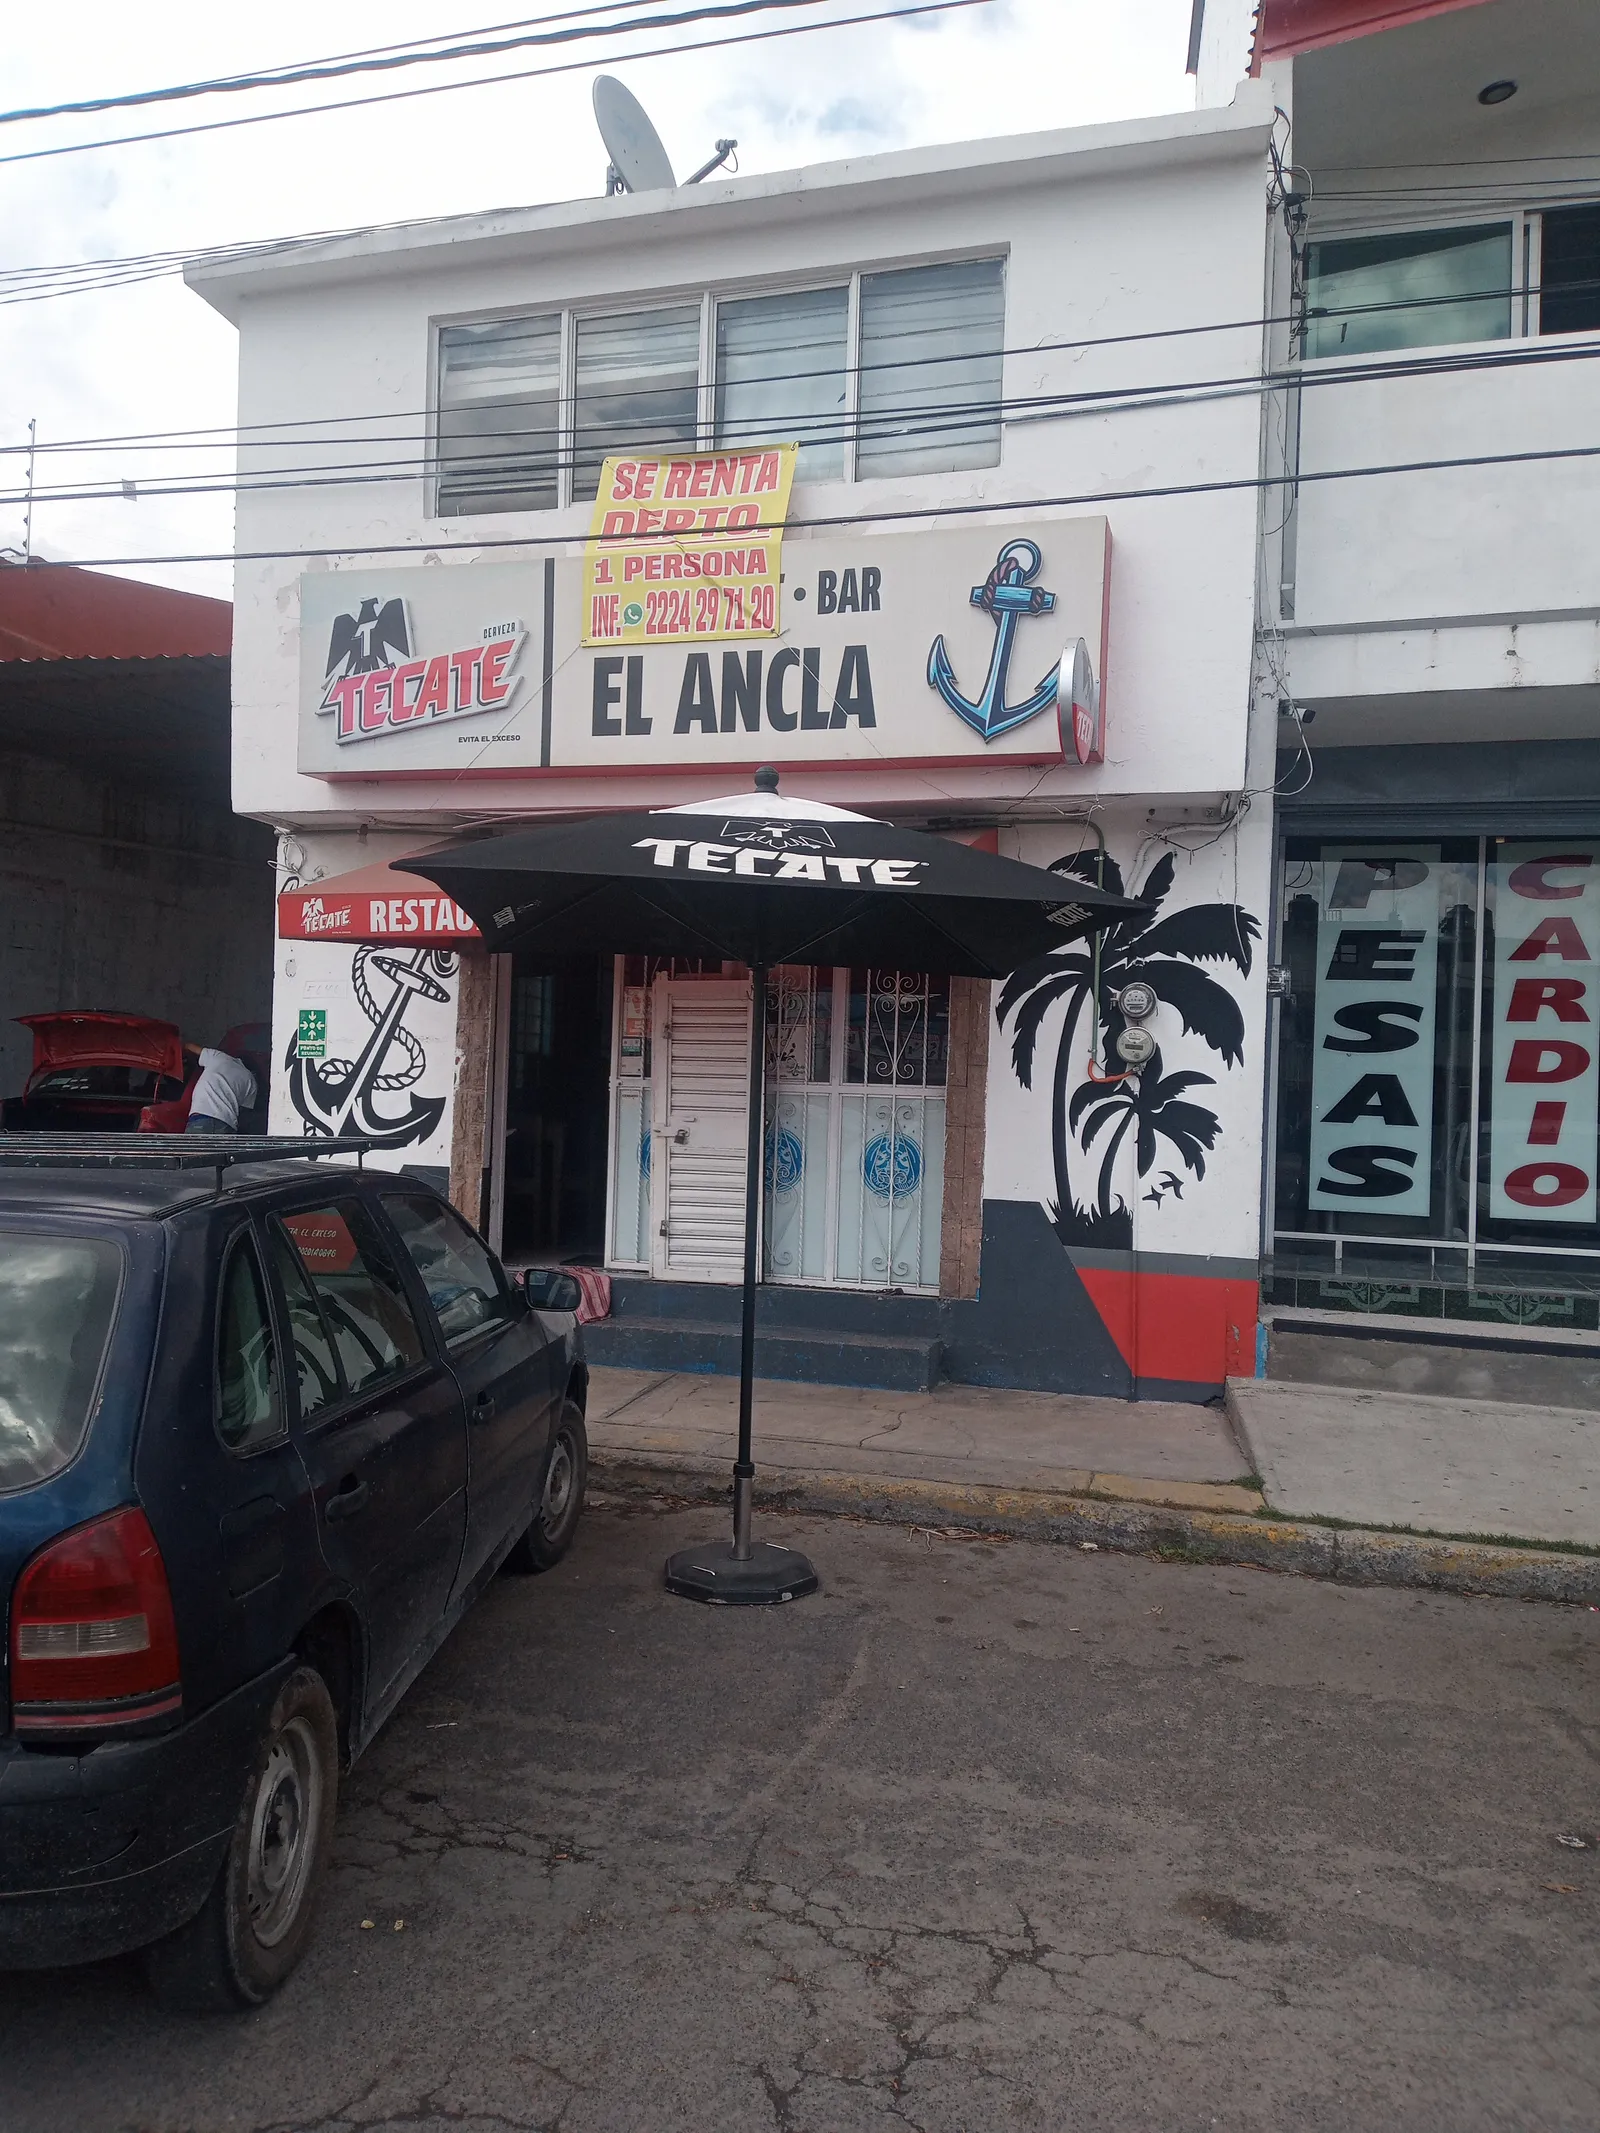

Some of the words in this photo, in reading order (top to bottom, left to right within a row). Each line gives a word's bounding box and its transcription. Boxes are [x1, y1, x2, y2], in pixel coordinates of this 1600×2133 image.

[612, 462, 659, 500] SE
[664, 453, 779, 498] RENTA
[600, 503, 770, 542] DEPTO.
[595, 559, 613, 584] 1
[624, 549, 767, 582] PERSONA
[818, 566, 881, 615] BAR
[483, 622, 516, 639] CERVEZA
[592, 595, 621, 637] INF.
[646, 590, 690, 634] 2224
[696, 588, 719, 631] 29
[724, 588, 745, 630] 71
[751, 585, 774, 629] 20
[322, 639, 516, 738] TECATE
[592, 655, 653, 736] EL
[673, 645, 877, 733] ANCLA
[631, 838, 921, 886] TECATE
[301, 909, 351, 934] TECATE
[369, 898, 479, 933] RESTAU
[1317, 858, 1430, 1198] PESAS
[1503, 854, 1594, 1207] CARDIO
